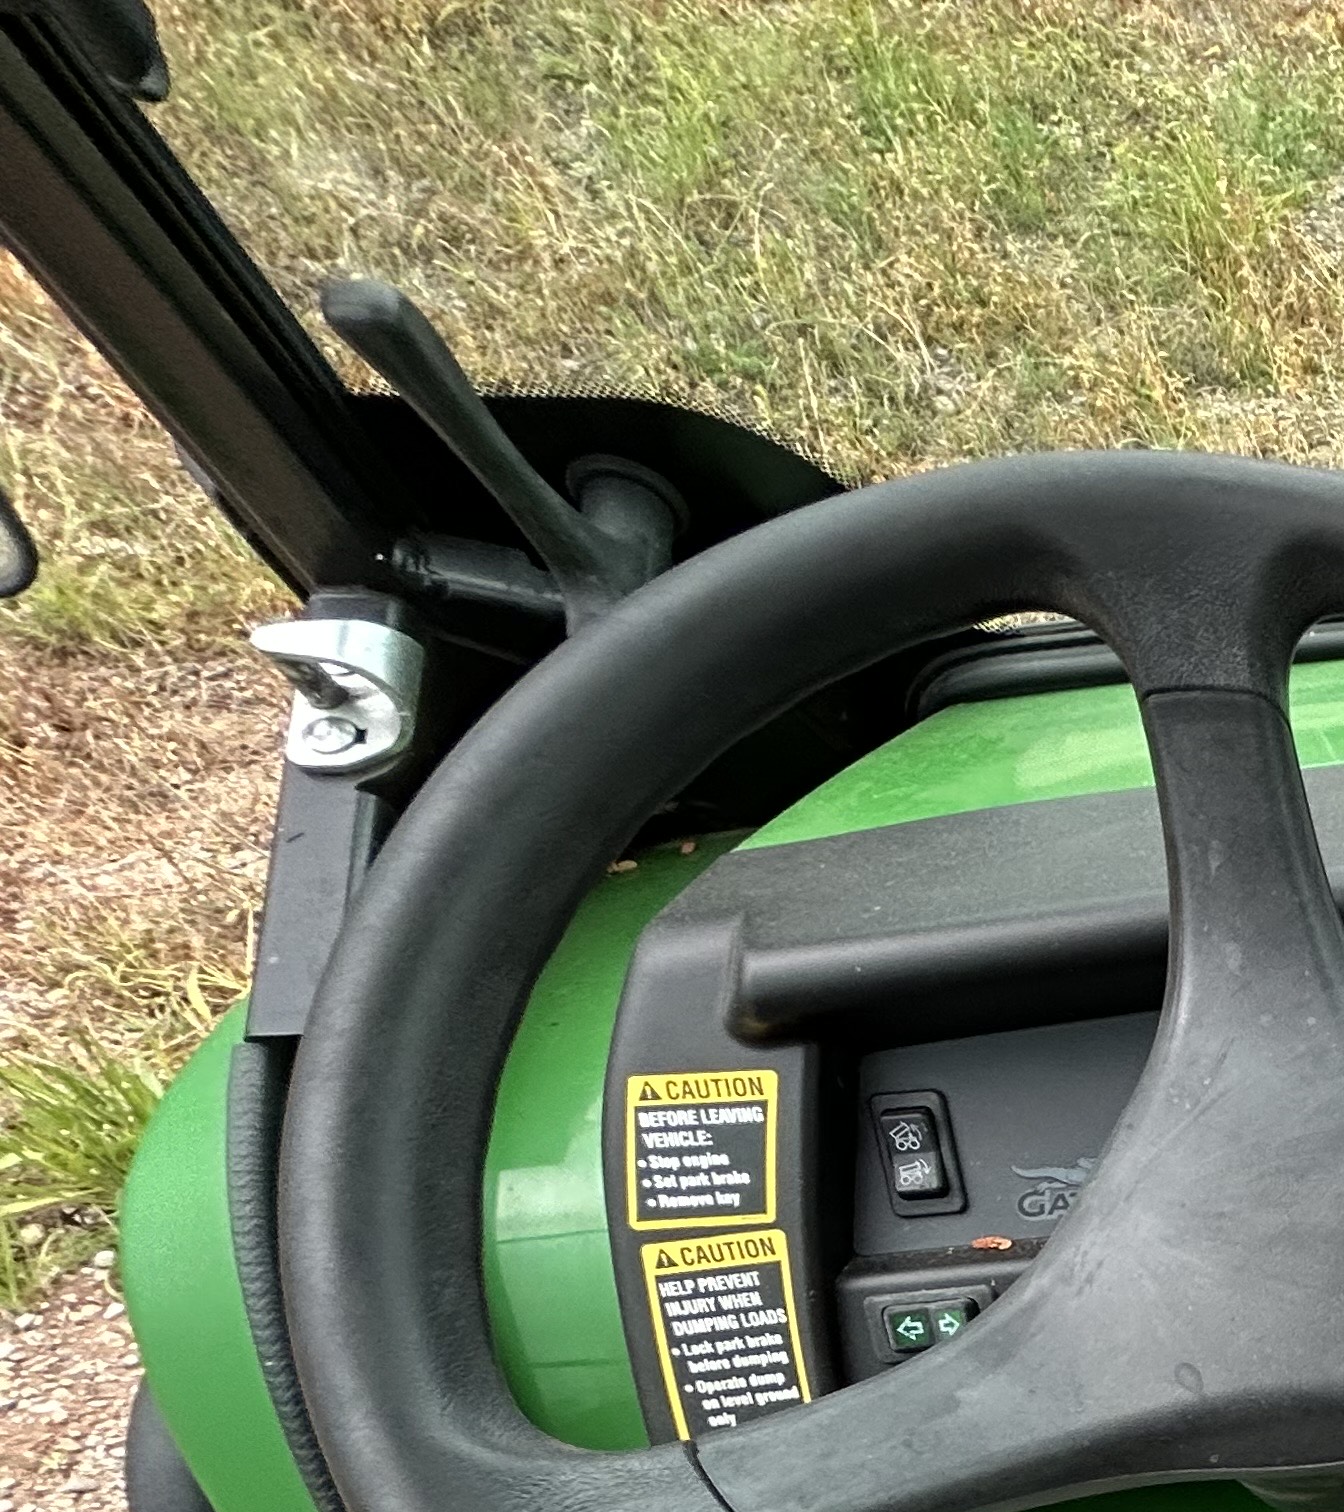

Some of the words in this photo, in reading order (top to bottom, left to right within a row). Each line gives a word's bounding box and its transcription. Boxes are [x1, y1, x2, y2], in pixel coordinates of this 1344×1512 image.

[665, 1076, 764, 1099] CAUTION
[638, 1109, 699, 1127] BEFORE
[700, 1106, 764, 1124] LEAVING
[642, 1129, 713, 1148] VEHICLE:
[647, 1153, 680, 1171] Stop
[681, 1151, 729, 1169] engine
[653, 1174, 677, 1188] Set
[678, 1172, 710, 1189] park
[710, 1169, 750, 1186] brake
[657, 1191, 714, 1208] Remove
[715, 1190, 740, 1208] key
[679, 1236, 776, 1266] CAUTION
[658, 1279, 696, 1297] HELP
[696, 1271, 760, 1293] PREVENT
[664, 1297, 717, 1317] INJURY
[716, 1290, 762, 1311] WHEN
[671, 1313, 739, 1337] DUMPING
[739, 1307, 787, 1328] LOADS
[680, 1340, 713, 1356] Lock
[713, 1336, 745, 1353] park
[744, 1331, 783, 1348] brake
[687, 1354, 731, 1374] before
[730, 1349, 789, 1370] dumping
[694, 1374, 747, 1394] Operate
[747, 1371, 785, 1387] dump
[701, 1397, 720, 1411] on
[719, 1391, 753, 1408] level
[753, 1384, 799, 1407] ground
[707, 1411, 737, 1431] only
